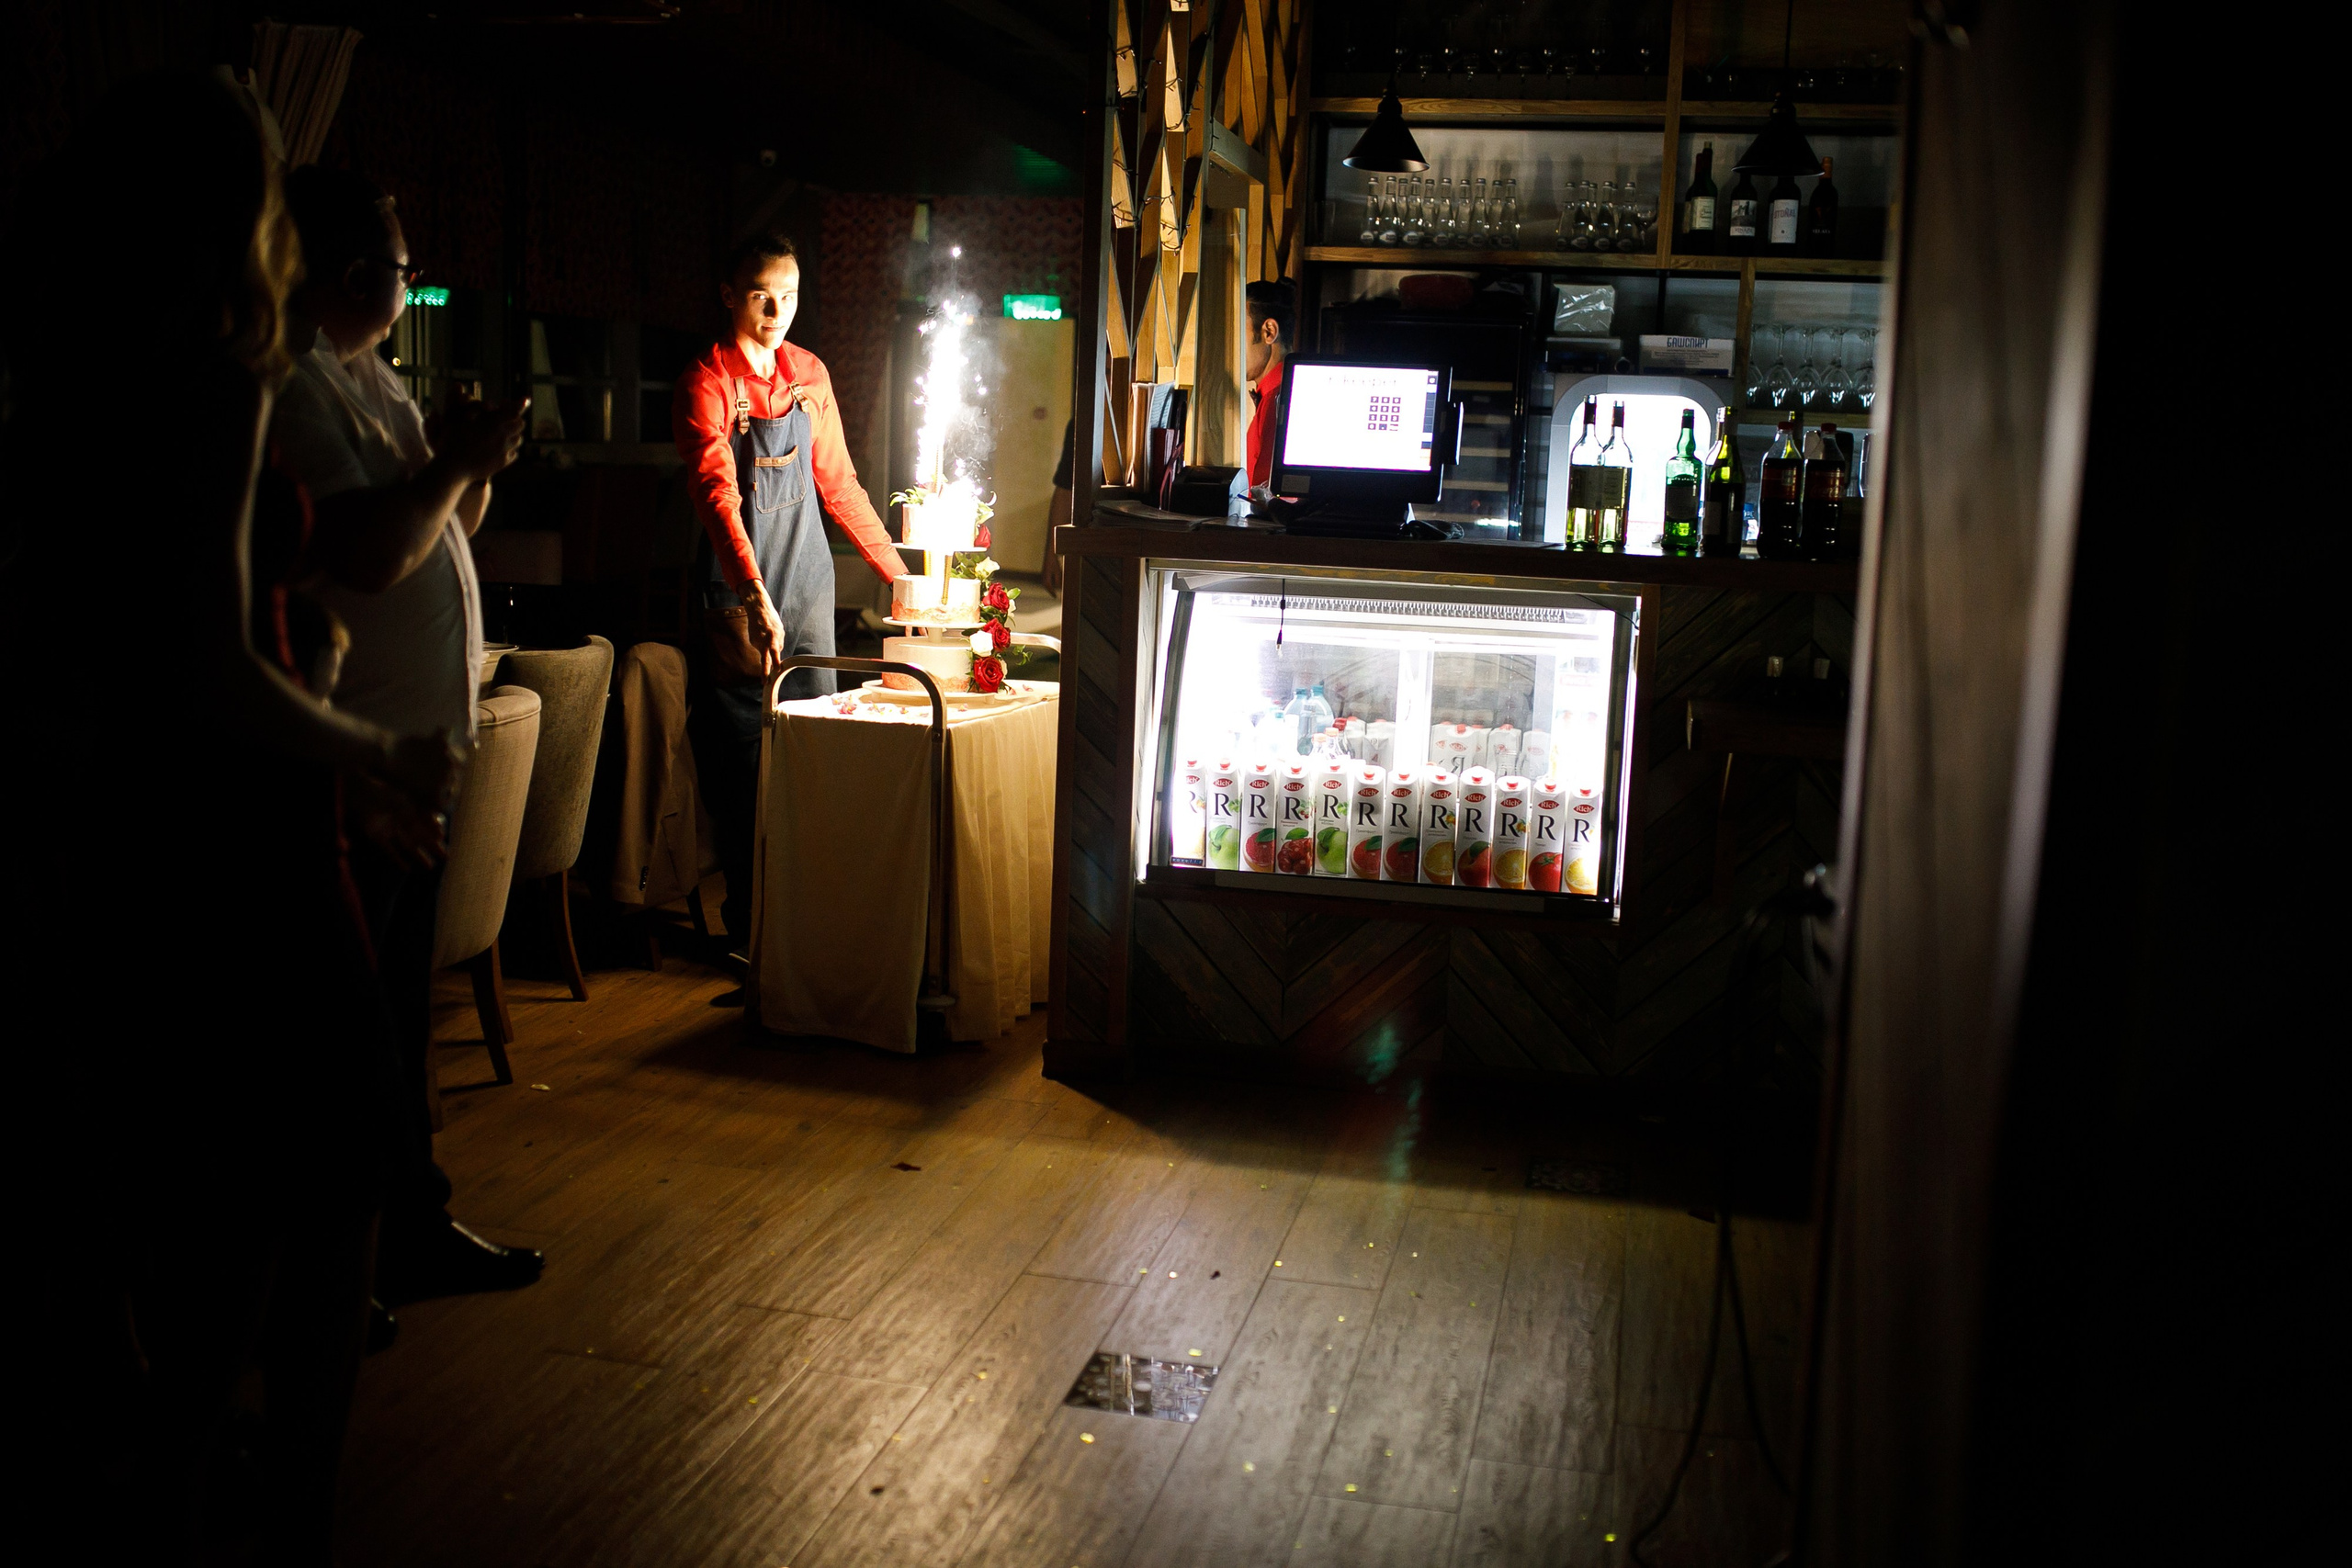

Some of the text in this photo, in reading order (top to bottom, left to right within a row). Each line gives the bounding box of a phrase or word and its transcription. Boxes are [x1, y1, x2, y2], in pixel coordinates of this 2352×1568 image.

[1667, 336, 1709, 348] БАШСПИРТ
[1360, 788, 1376, 796] Rich
[1393, 788, 1409, 796] Rich
[1432, 791, 1449, 799] Rich
[1467, 794, 1484, 802] Rich
[1503, 798, 1520, 807] Rich
[1215, 793, 1232, 817] R
[1249, 794, 1268, 818] R
[1284, 796, 1304, 820] R
[1323, 794, 1340, 818] R
[1357, 802, 1377, 826] R
[1390, 803, 1410, 828] R
[1430, 805, 1450, 829] R
[1464, 807, 1485, 833] R
[1499, 812, 1521, 837] R
[1536, 815, 1557, 840] R
[1572, 818, 1590, 842] R
